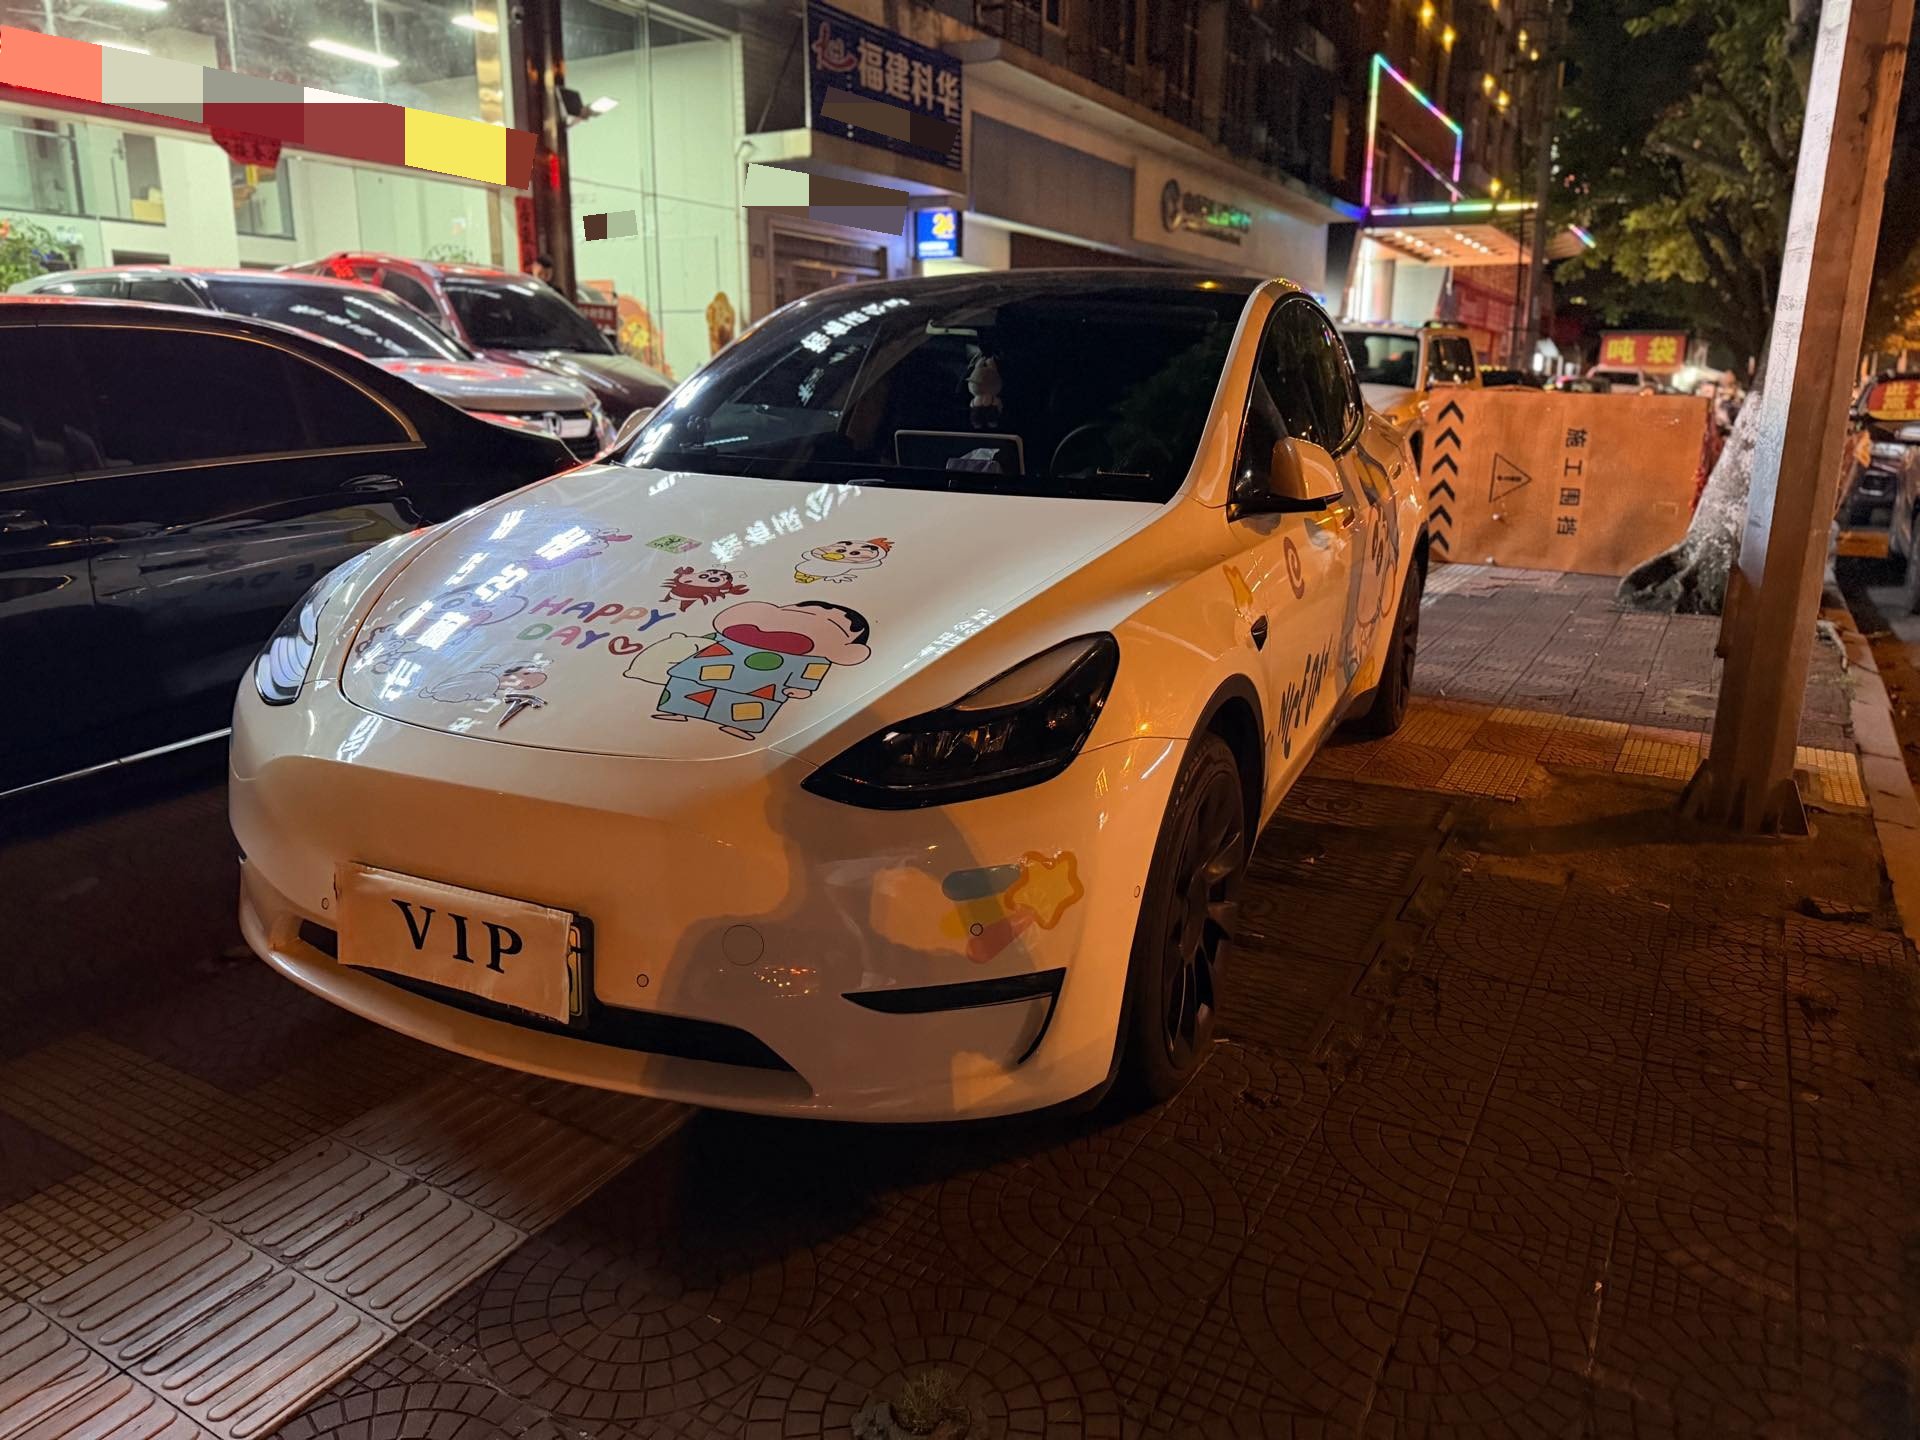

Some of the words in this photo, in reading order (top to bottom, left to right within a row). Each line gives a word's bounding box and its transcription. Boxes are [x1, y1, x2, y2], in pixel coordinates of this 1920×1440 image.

[856, 36, 960, 117] 福建科华
[1556, 428, 1588, 535] 施工围挡
[516, 623, 610, 649] DAY
[528, 595, 676, 632] HAPPY
[391, 898, 524, 974] VIP
